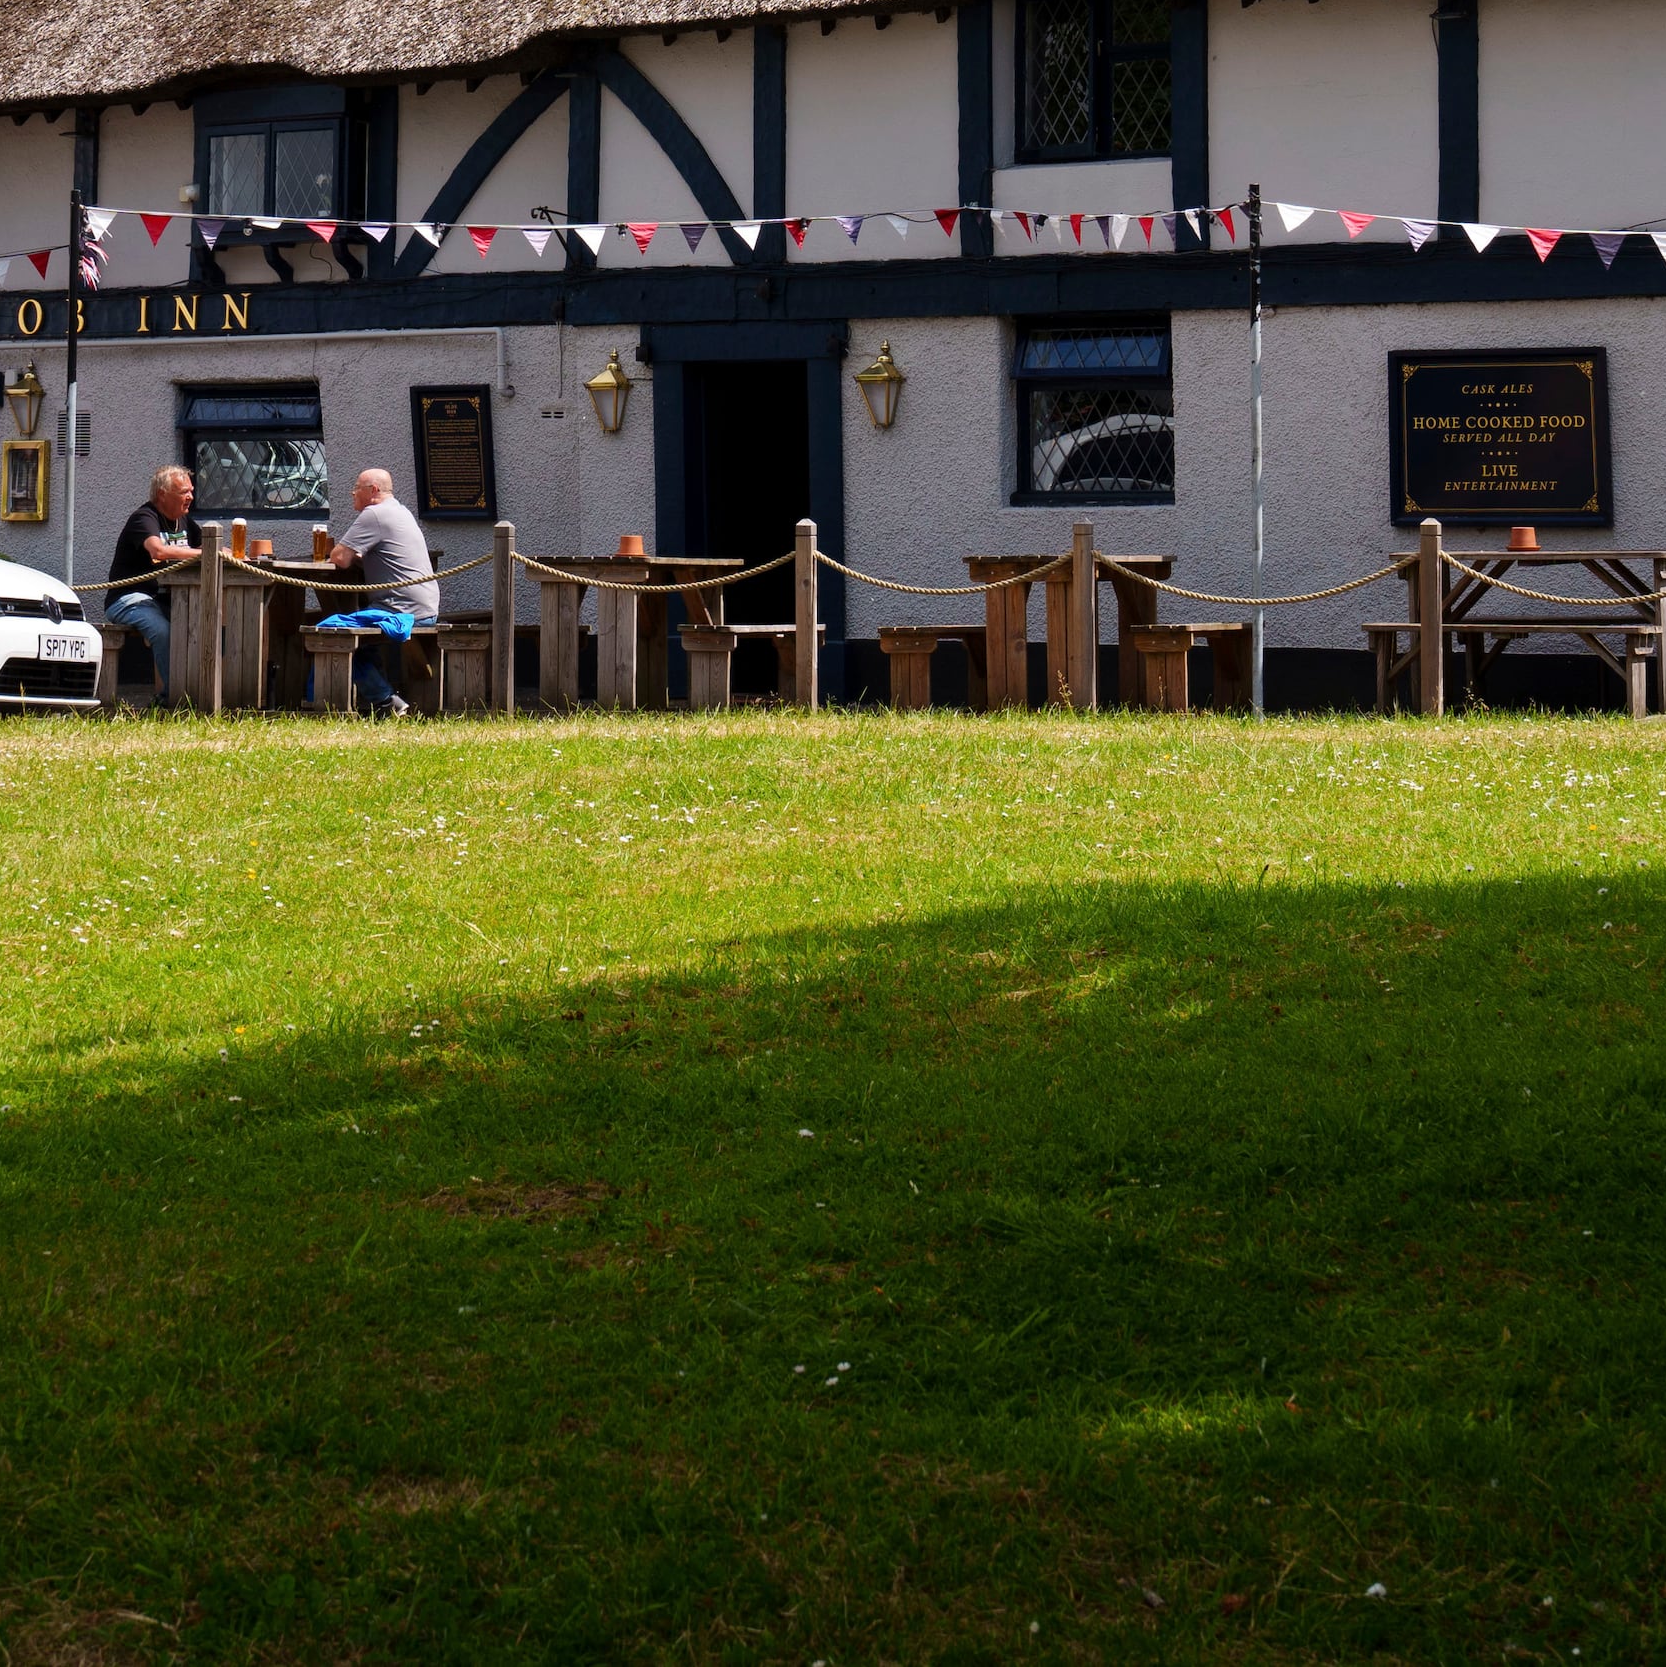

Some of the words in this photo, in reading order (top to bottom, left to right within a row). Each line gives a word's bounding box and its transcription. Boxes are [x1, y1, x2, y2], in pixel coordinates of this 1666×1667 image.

[139, 293, 250, 331] INN
[1462, 385, 1494, 394] CASK
[1502, 384, 1533, 394] ALES
[1414, 417, 1459, 430] HOME
[1465, 415, 1535, 429] COOKED
[1540, 415, 1586, 428] FOOD
[1444, 433, 1492, 443] SERVED
[1499, 433, 1521, 443] ALL
[1528, 432, 1554, 443] DAY
[1482, 464, 1518, 478] LIVE
[1445, 481, 1556, 491] ENTERTAINMENT
[46, 639, 67, 657] SP17
[70, 640, 85, 658] YPG
